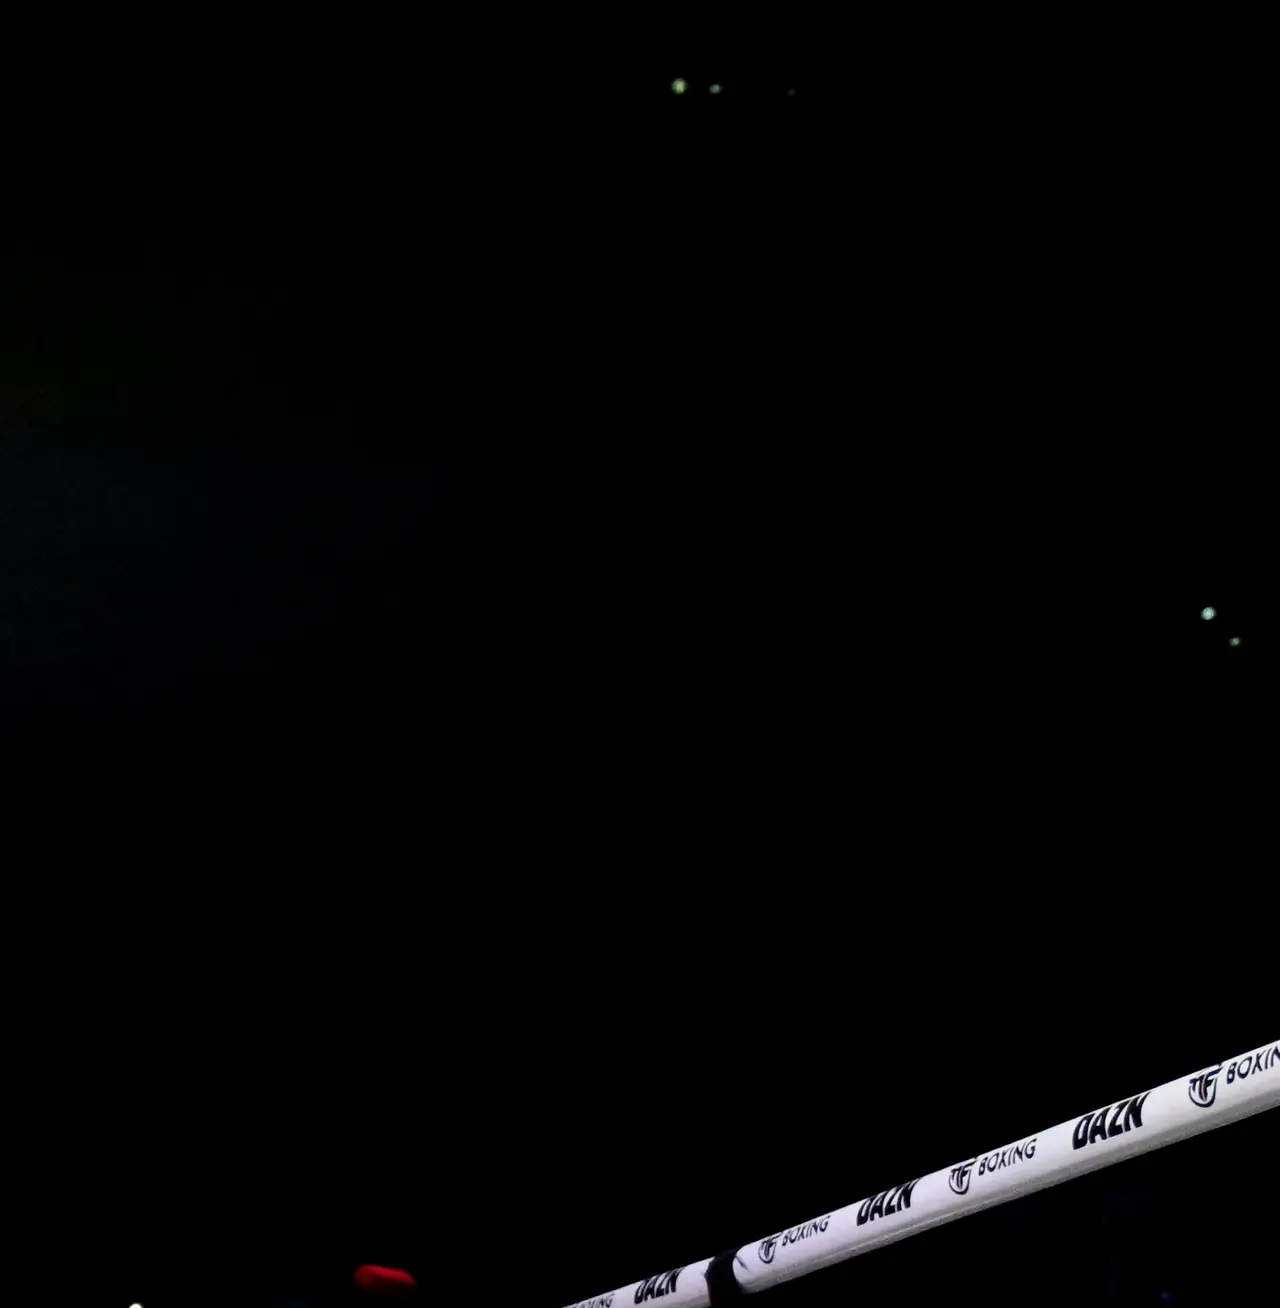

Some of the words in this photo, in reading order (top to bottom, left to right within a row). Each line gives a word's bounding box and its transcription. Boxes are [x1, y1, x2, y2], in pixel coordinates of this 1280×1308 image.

[781, 1215, 830, 1248] BOXING
[856, 1177, 924, 1227] DAZN
[978, 1137, 1037, 1177] BOXING
[1072, 1091, 1152, 1151] DAZN
[1226, 1044, 1280, 1085] BOXIN
